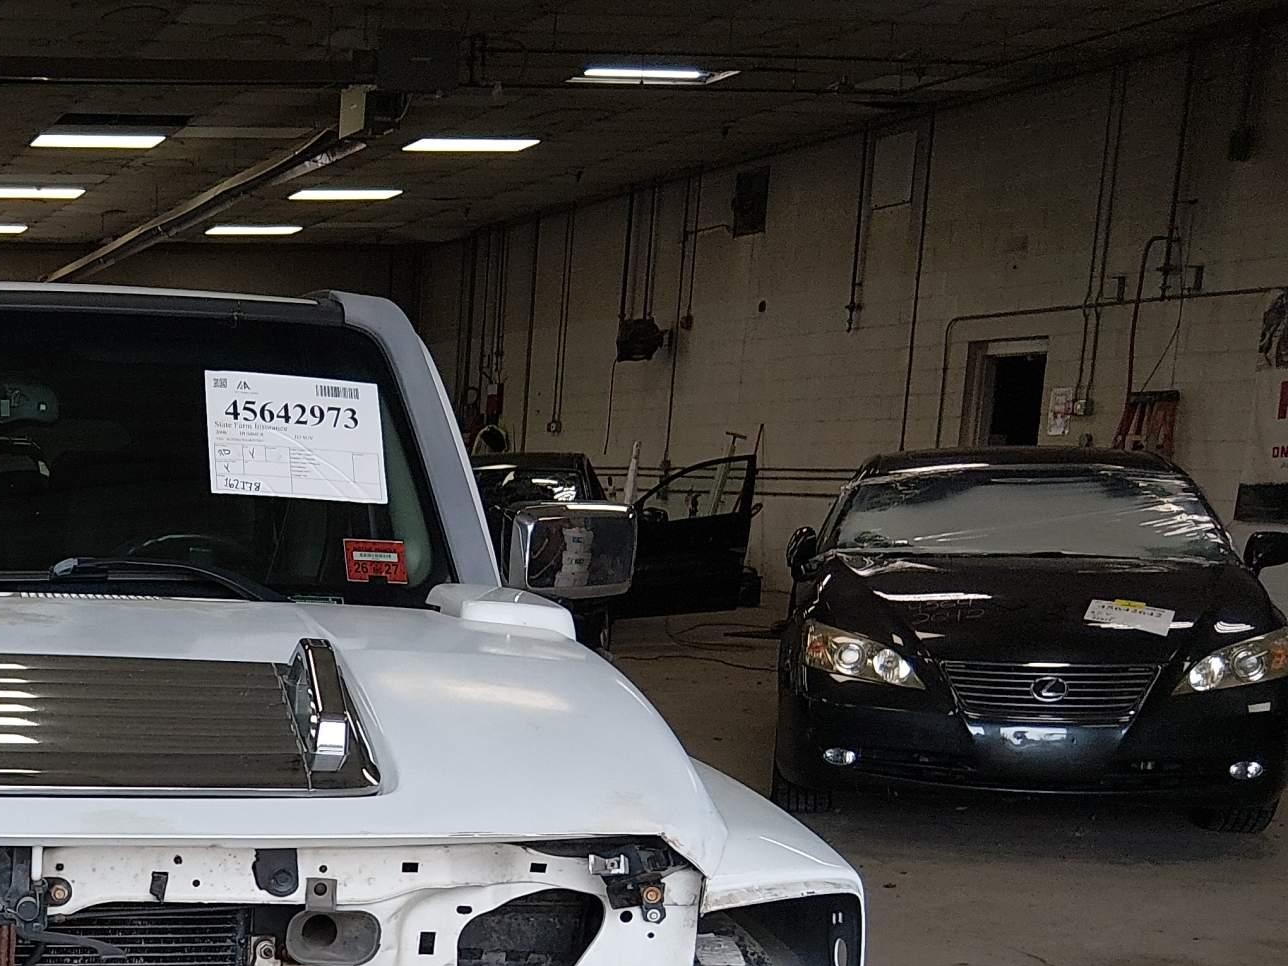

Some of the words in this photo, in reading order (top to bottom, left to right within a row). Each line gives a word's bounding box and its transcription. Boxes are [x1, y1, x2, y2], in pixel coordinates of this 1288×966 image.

[224, 399, 360, 430] 45642973
[354, 562, 369, 573] 26
[384, 564, 399, 575] 27
